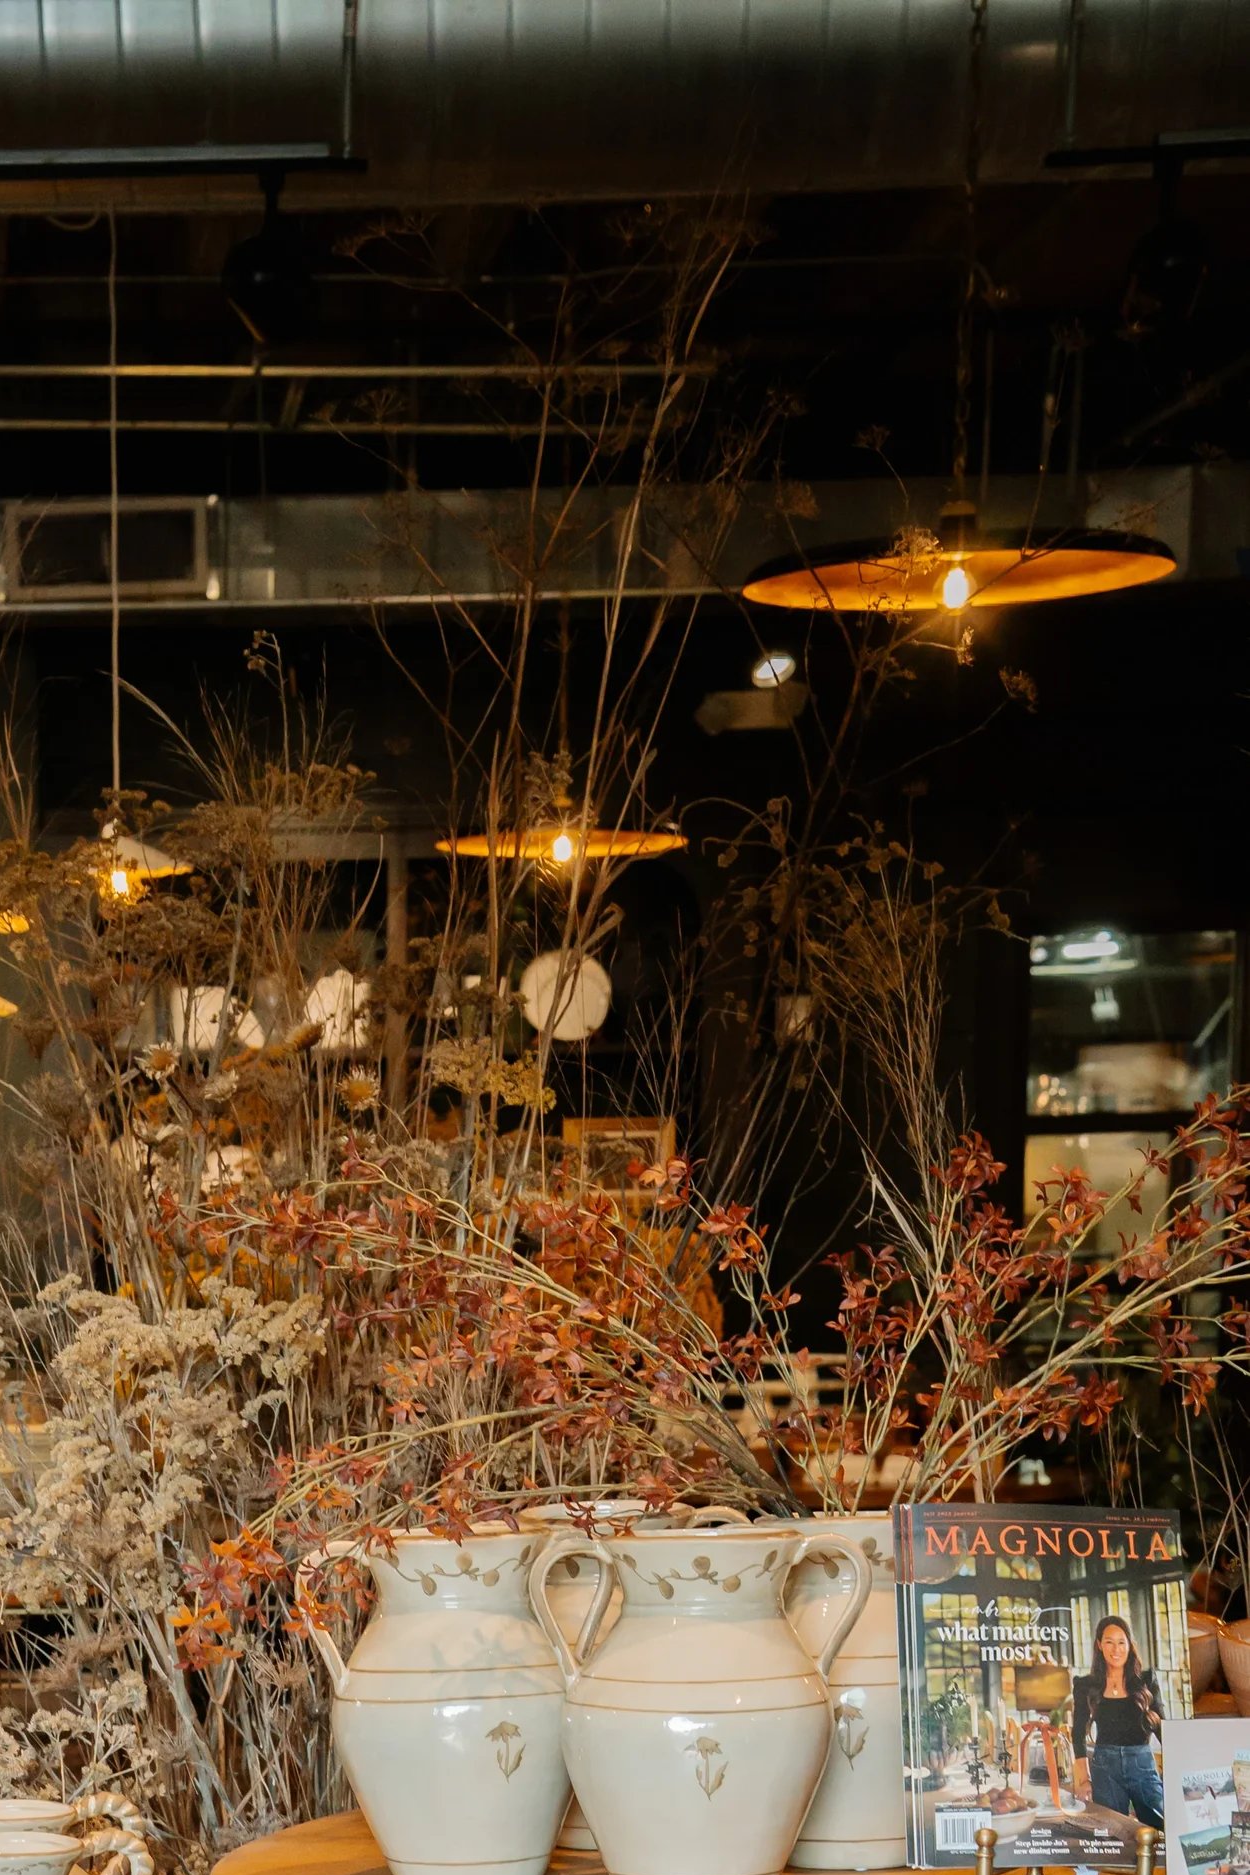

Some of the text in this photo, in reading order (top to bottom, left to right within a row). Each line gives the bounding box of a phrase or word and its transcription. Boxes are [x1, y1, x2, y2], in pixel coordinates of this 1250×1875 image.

[924, 1524, 1172, 1561] MAGNOLIA
[937, 1621, 1069, 1642] what matters
[980, 1644, 1033, 1662] most
[1183, 1771, 1231, 1783] MAGNOLIA
[1015, 1840, 1031, 1848] Step
[1029, 1847, 1051, 1856] dining
[1083, 1847, 1099, 1855] with
